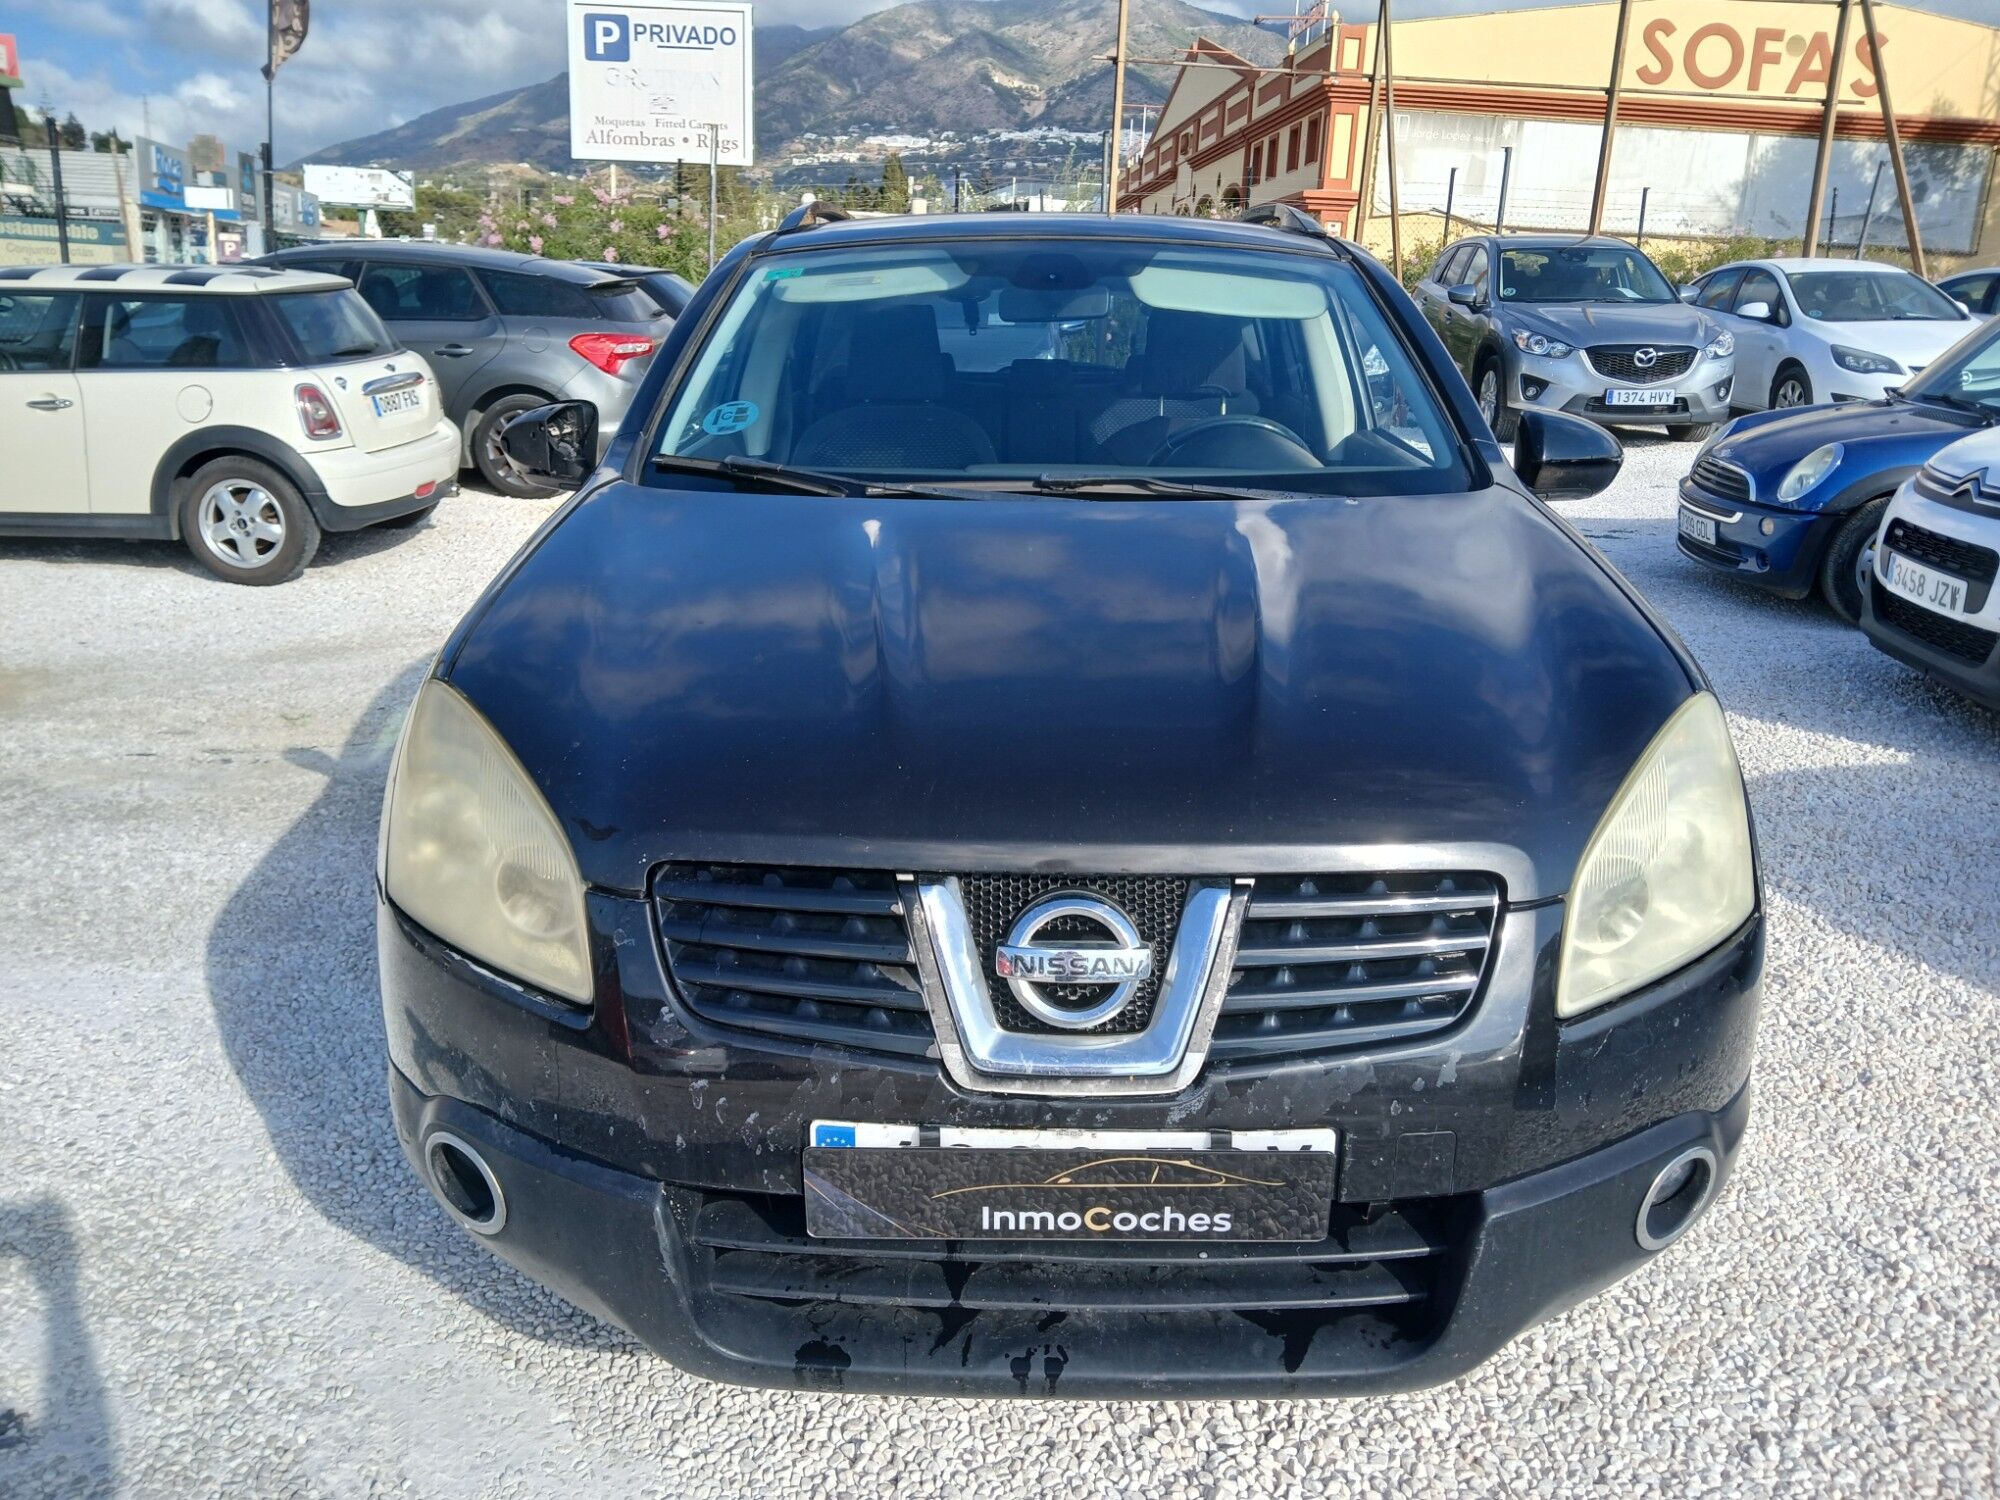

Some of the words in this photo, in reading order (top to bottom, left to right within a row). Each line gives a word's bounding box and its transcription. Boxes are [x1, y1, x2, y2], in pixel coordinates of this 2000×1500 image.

[594, 20, 621, 55] P
[633, 23, 736, 46] PRIVADO
[1635, 18, 1890, 98] SOFAS
[594, 116, 646, 128] Moquetas
[655, 118, 686, 129] Fitted
[585, 130, 676, 147] Alfombras
[1616, 391, 1646, 404] 1374
[1650, 391, 1673, 403] HVY
[1894, 563, 1926, 597] 3458
[1929, 580, 1960, 611] JZW
[1010, 953, 1136, 976] NISSAN
[982, 1206, 1232, 1232] InmoCoches
